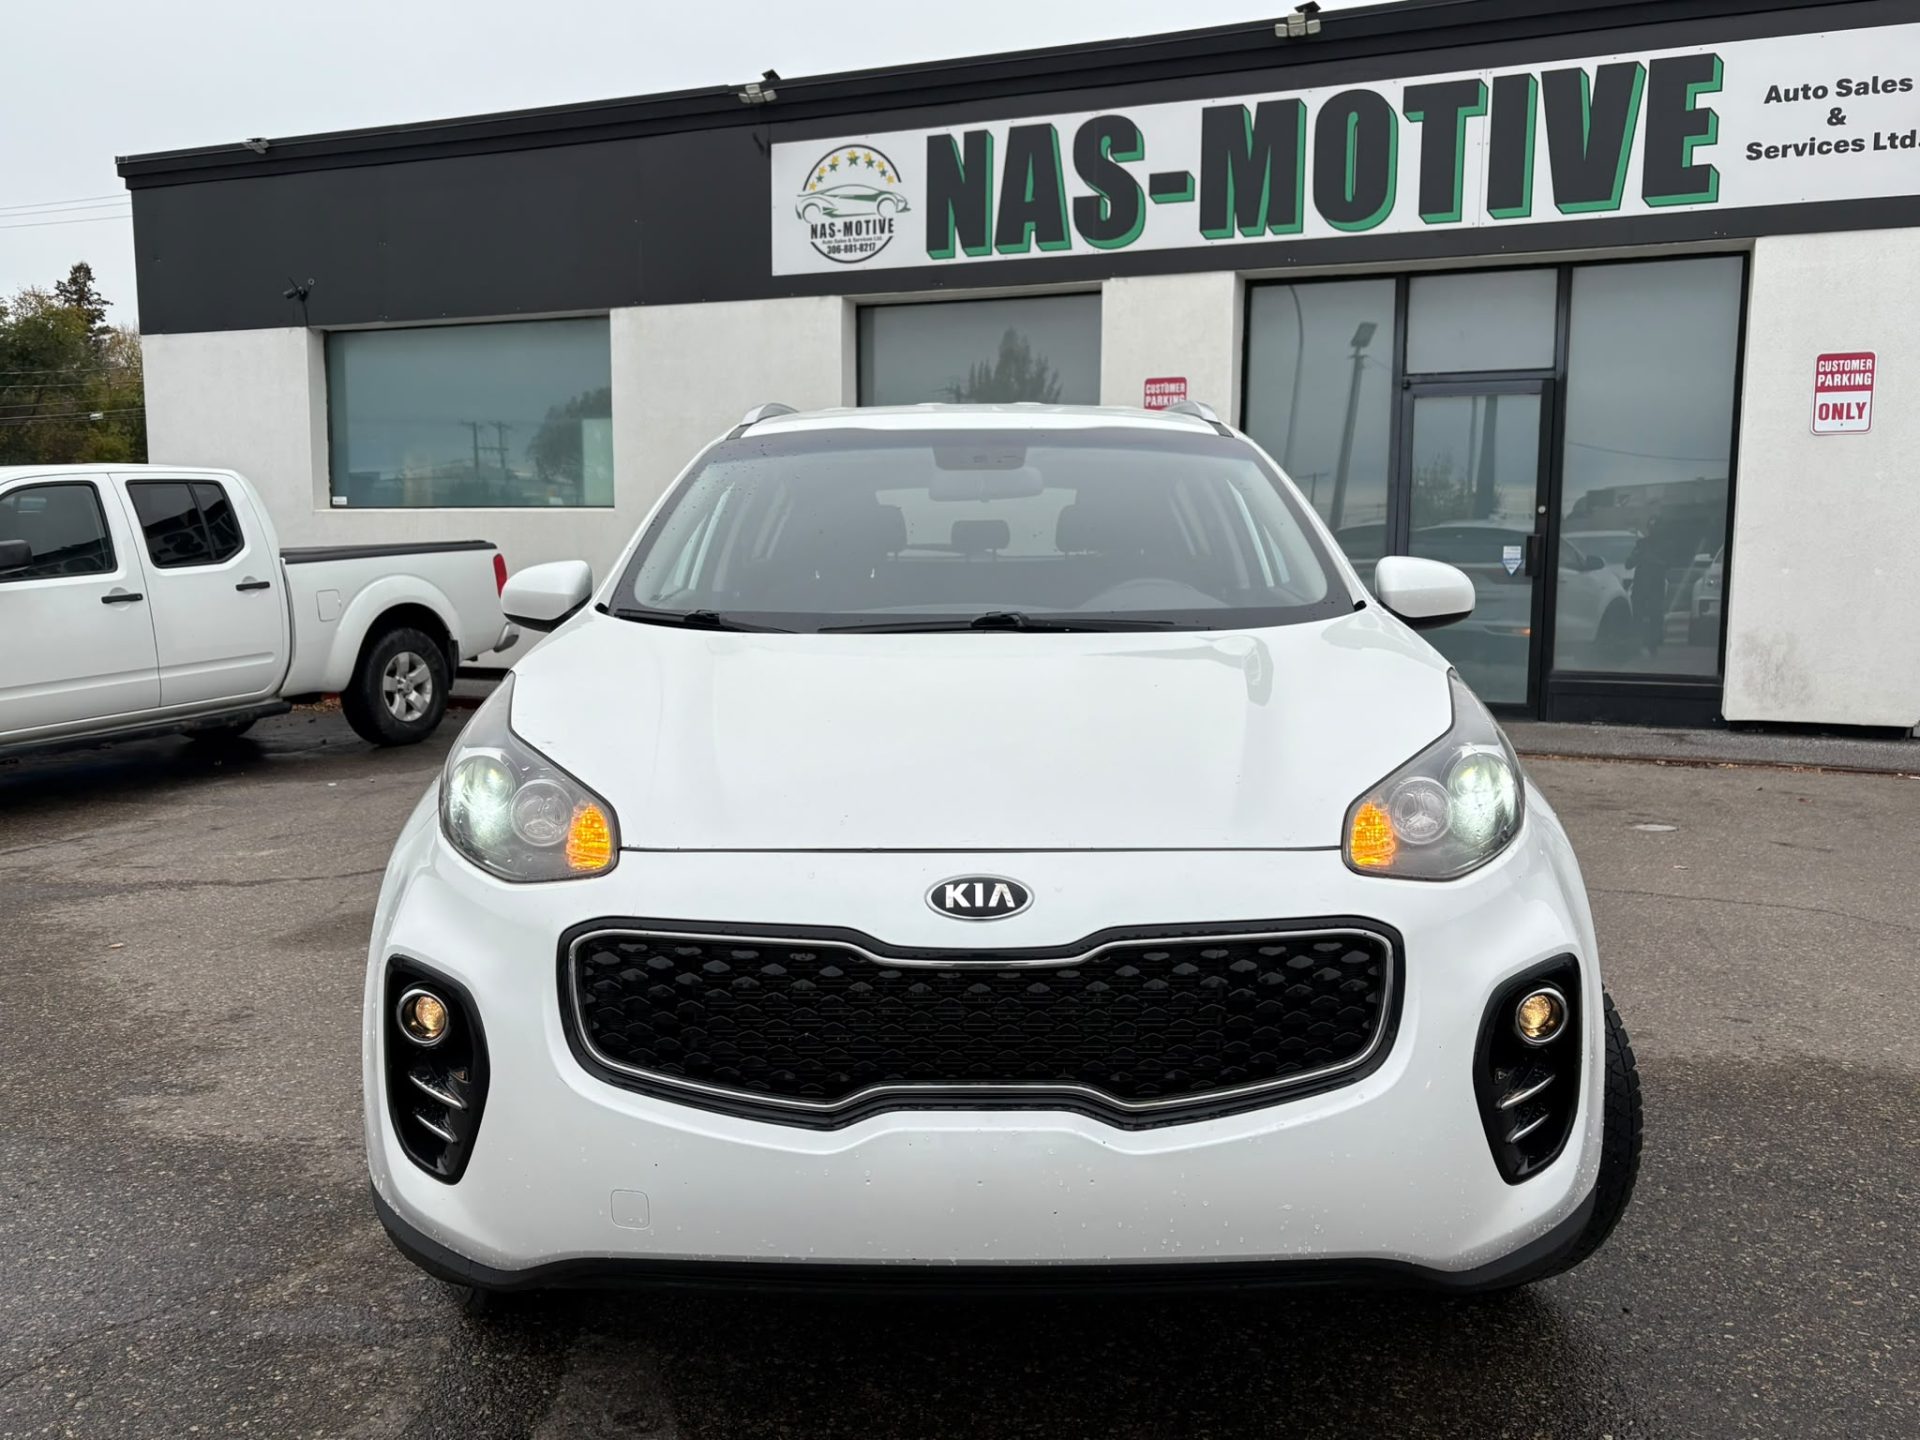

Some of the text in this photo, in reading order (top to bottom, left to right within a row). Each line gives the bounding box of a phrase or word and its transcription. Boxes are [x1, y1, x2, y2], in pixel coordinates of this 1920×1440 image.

[1763, 75, 1914, 104] Auto Sales
[1826, 107, 1847, 126] &
[926, 52, 1724, 260] NAS-MOTIVE
[1745, 137, 1866, 161] Services
[811, 218, 894, 240] NAS-MOTIVE
[1818, 358, 1872, 372] CUSTOMER
[1146, 382, 1185, 394] CUSTOMER
[1818, 372, 1872, 387] PARKING
[1818, 402, 1867, 421] ONLY
[944, 882, 1016, 909] KIA
